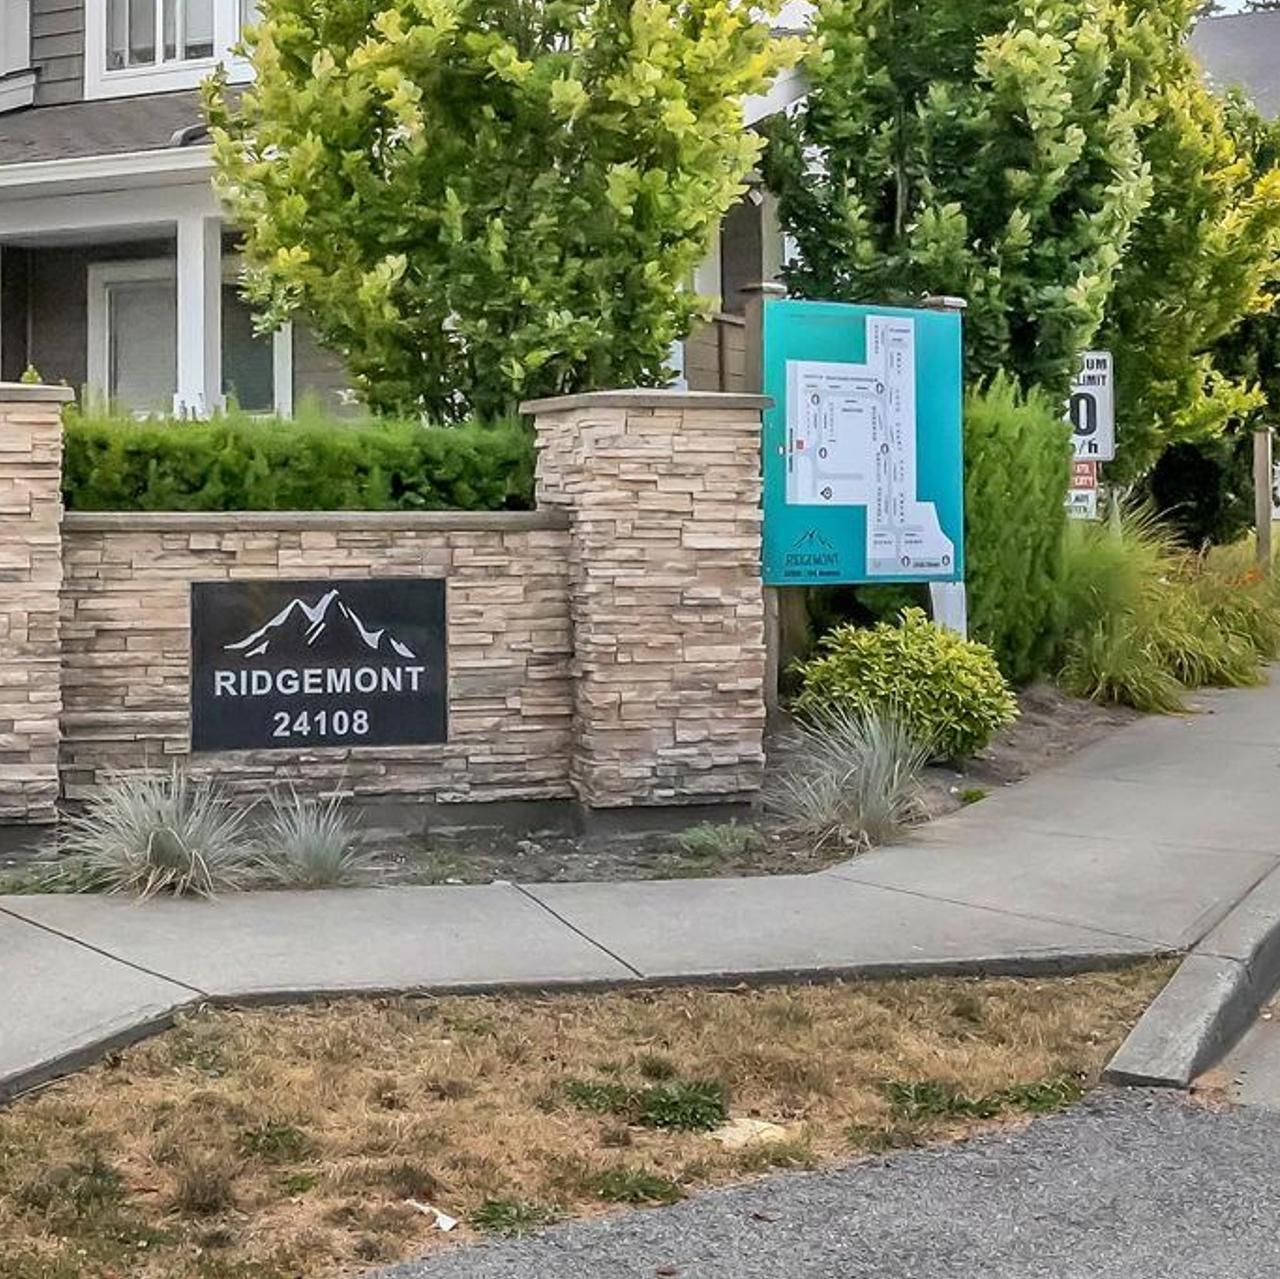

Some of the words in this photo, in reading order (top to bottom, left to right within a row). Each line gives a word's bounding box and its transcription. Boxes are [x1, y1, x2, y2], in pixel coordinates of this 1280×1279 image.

[1070, 393, 1097, 436] 0
[214, 667, 425, 696] RIDGEMONT
[272, 710, 369, 737] 24108
